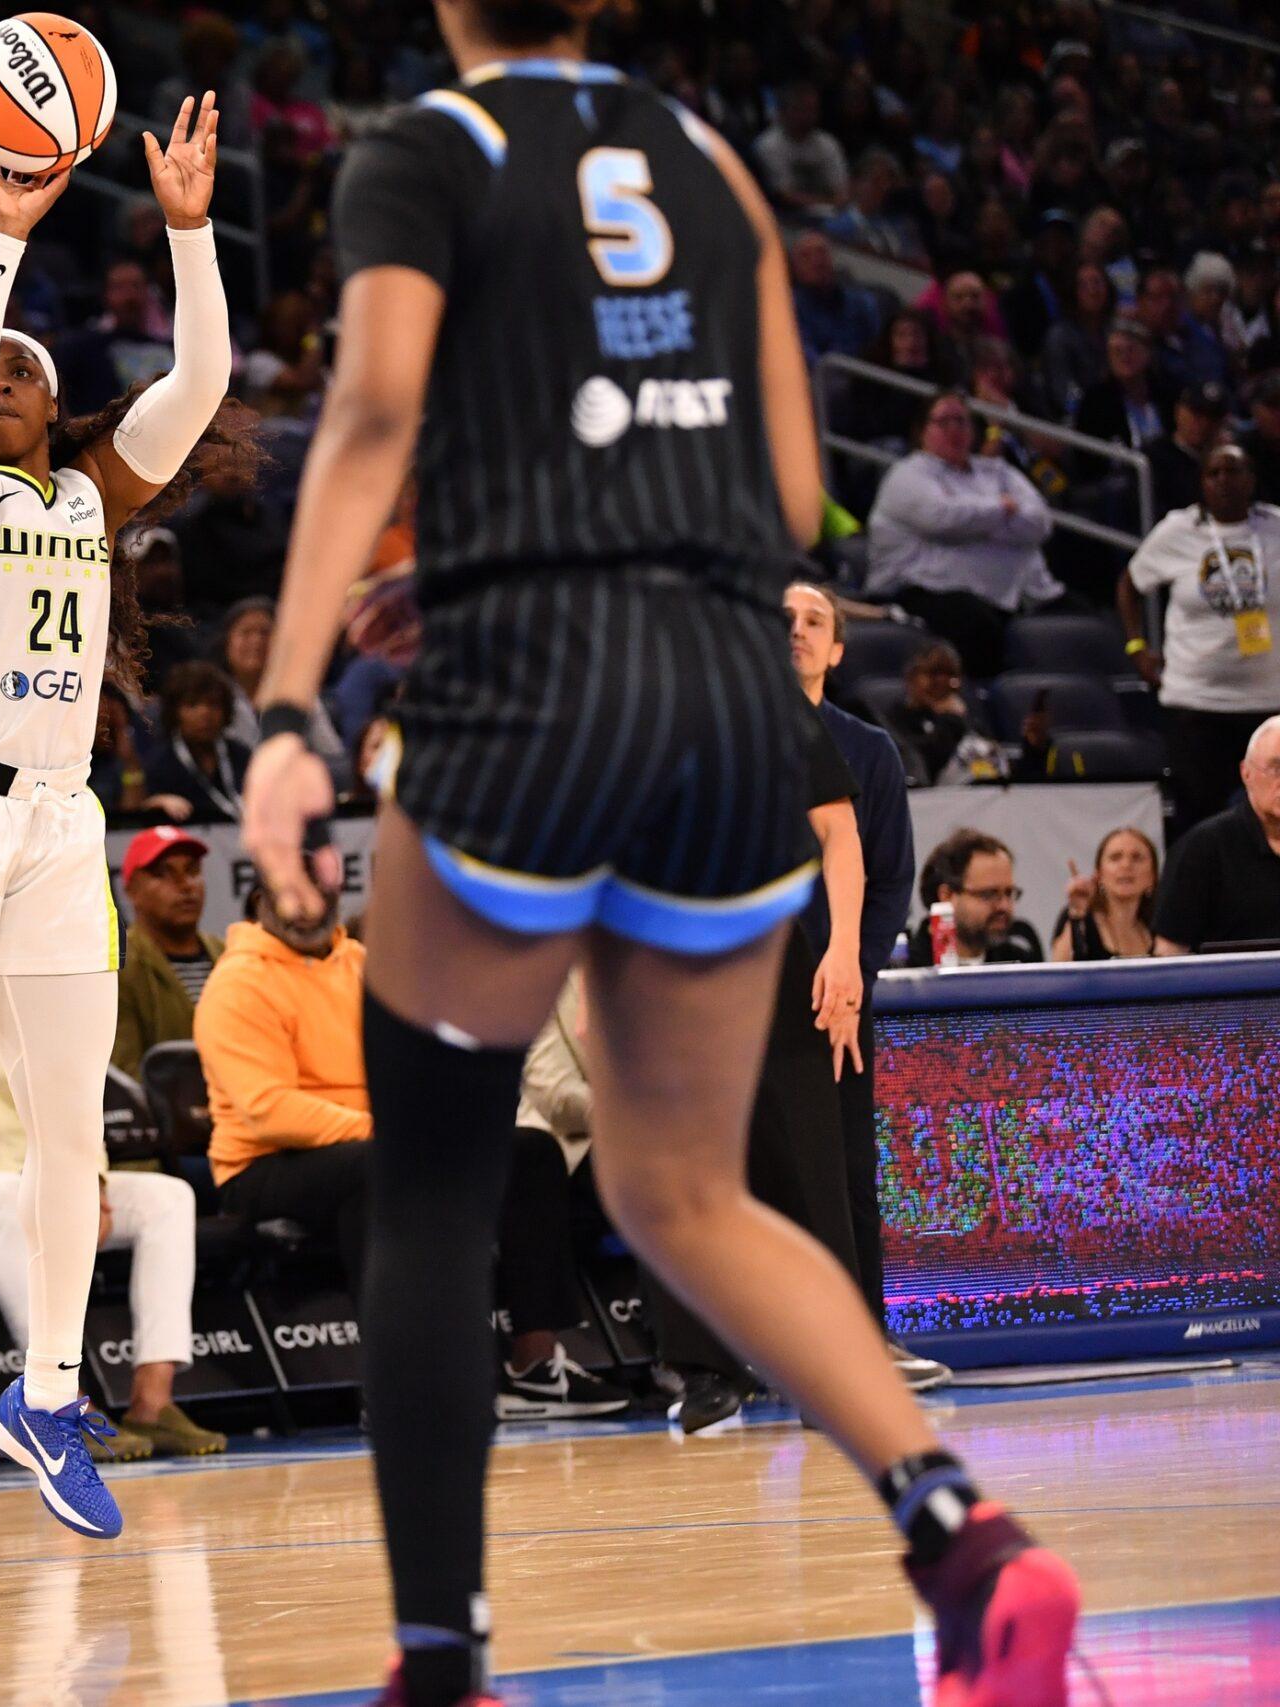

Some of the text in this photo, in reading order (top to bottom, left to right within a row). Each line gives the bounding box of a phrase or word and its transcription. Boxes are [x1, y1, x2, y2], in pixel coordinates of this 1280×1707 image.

[577, 146, 675, 287] 5
[69, 506, 98, 525] Albert
[27, 588, 83, 656] 24
[100, 1329, 253, 1365] COGIRL
[274, 1320, 361, 1350] COVER
